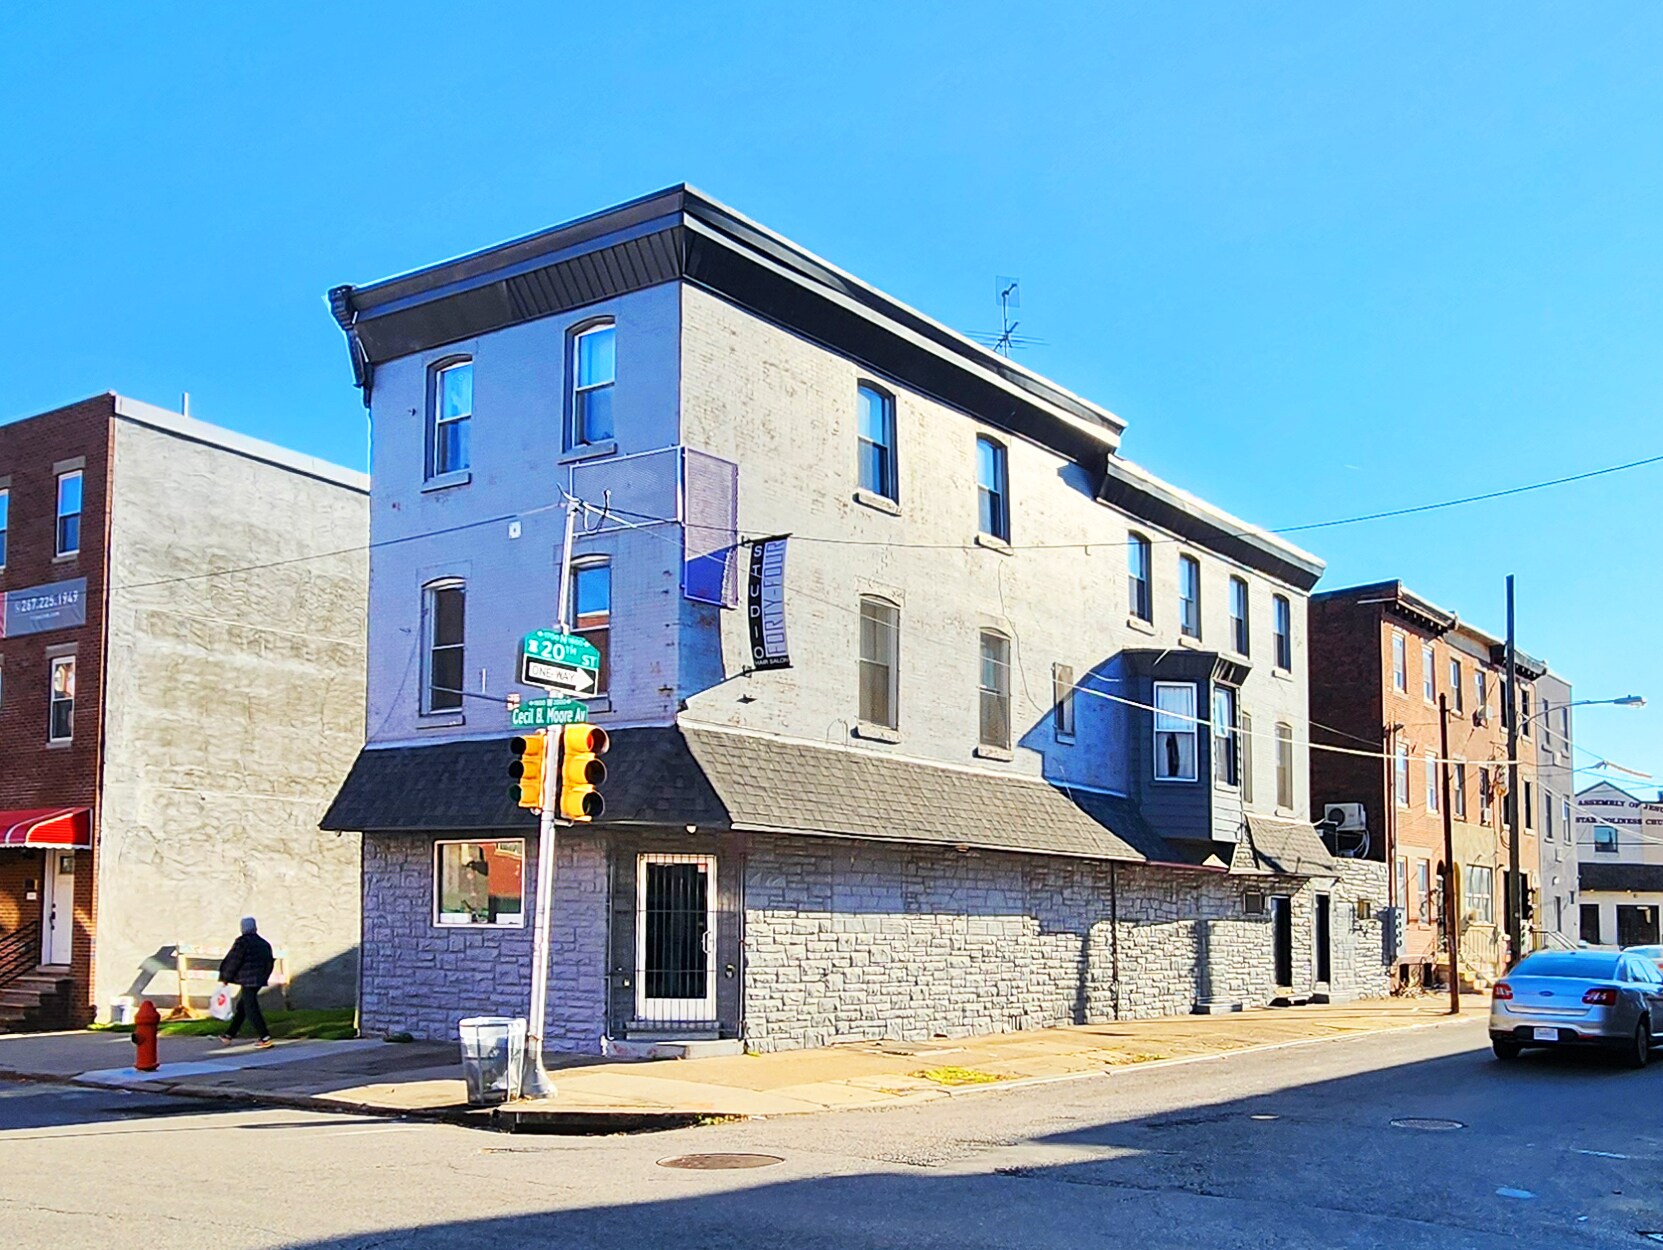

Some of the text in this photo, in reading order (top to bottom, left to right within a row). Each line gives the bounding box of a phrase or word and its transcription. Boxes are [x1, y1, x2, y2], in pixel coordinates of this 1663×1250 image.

[750, 545, 764, 659] STUDIO
[763, 541, 786, 656] FORTY-FOUR
[581, 654, 597, 667] ST
[769, 657, 789, 665] SALON
[512, 707, 534, 725] Cecil
[547, 706, 573, 724] Moore
[574, 706, 586, 723] Av
